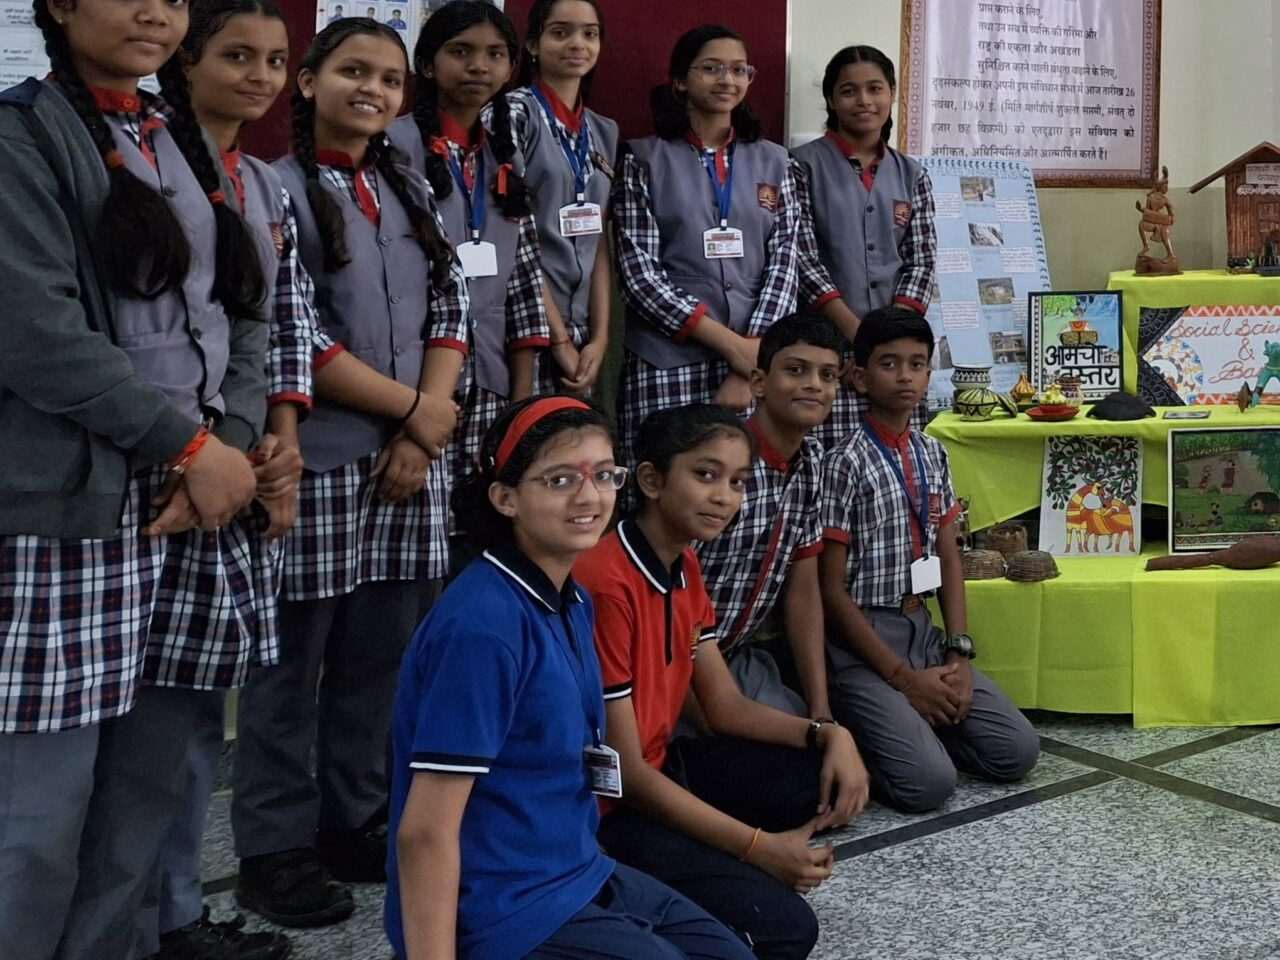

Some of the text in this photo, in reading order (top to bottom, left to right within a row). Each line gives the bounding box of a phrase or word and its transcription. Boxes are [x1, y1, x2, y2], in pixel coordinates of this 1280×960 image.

[1084, 27, 1096, 40] और
[993, 38, 1004, 51] की
[1032, 40, 1046, 54] और
[1092, 64, 1098, 76] के
[1085, 85, 1100, 95] आज
[1125, 87, 1134, 97] 26
[963, 100, 983, 112] 1949
[1128, 106, 1134, 117] दो
[1014, 123, 1024, 134] को
[1069, 127, 1081, 137] इस
[1087, 125, 1117, 137] संविधान
[1124, 125, 1134, 137] को
[1023, 145, 1037, 157] और
[1079, 147, 1096, 159] करते
[1170, 318, 1232, 338] Social
[1045, 345, 1108, 366] आमचा
[1239, 338, 1254, 361] &
